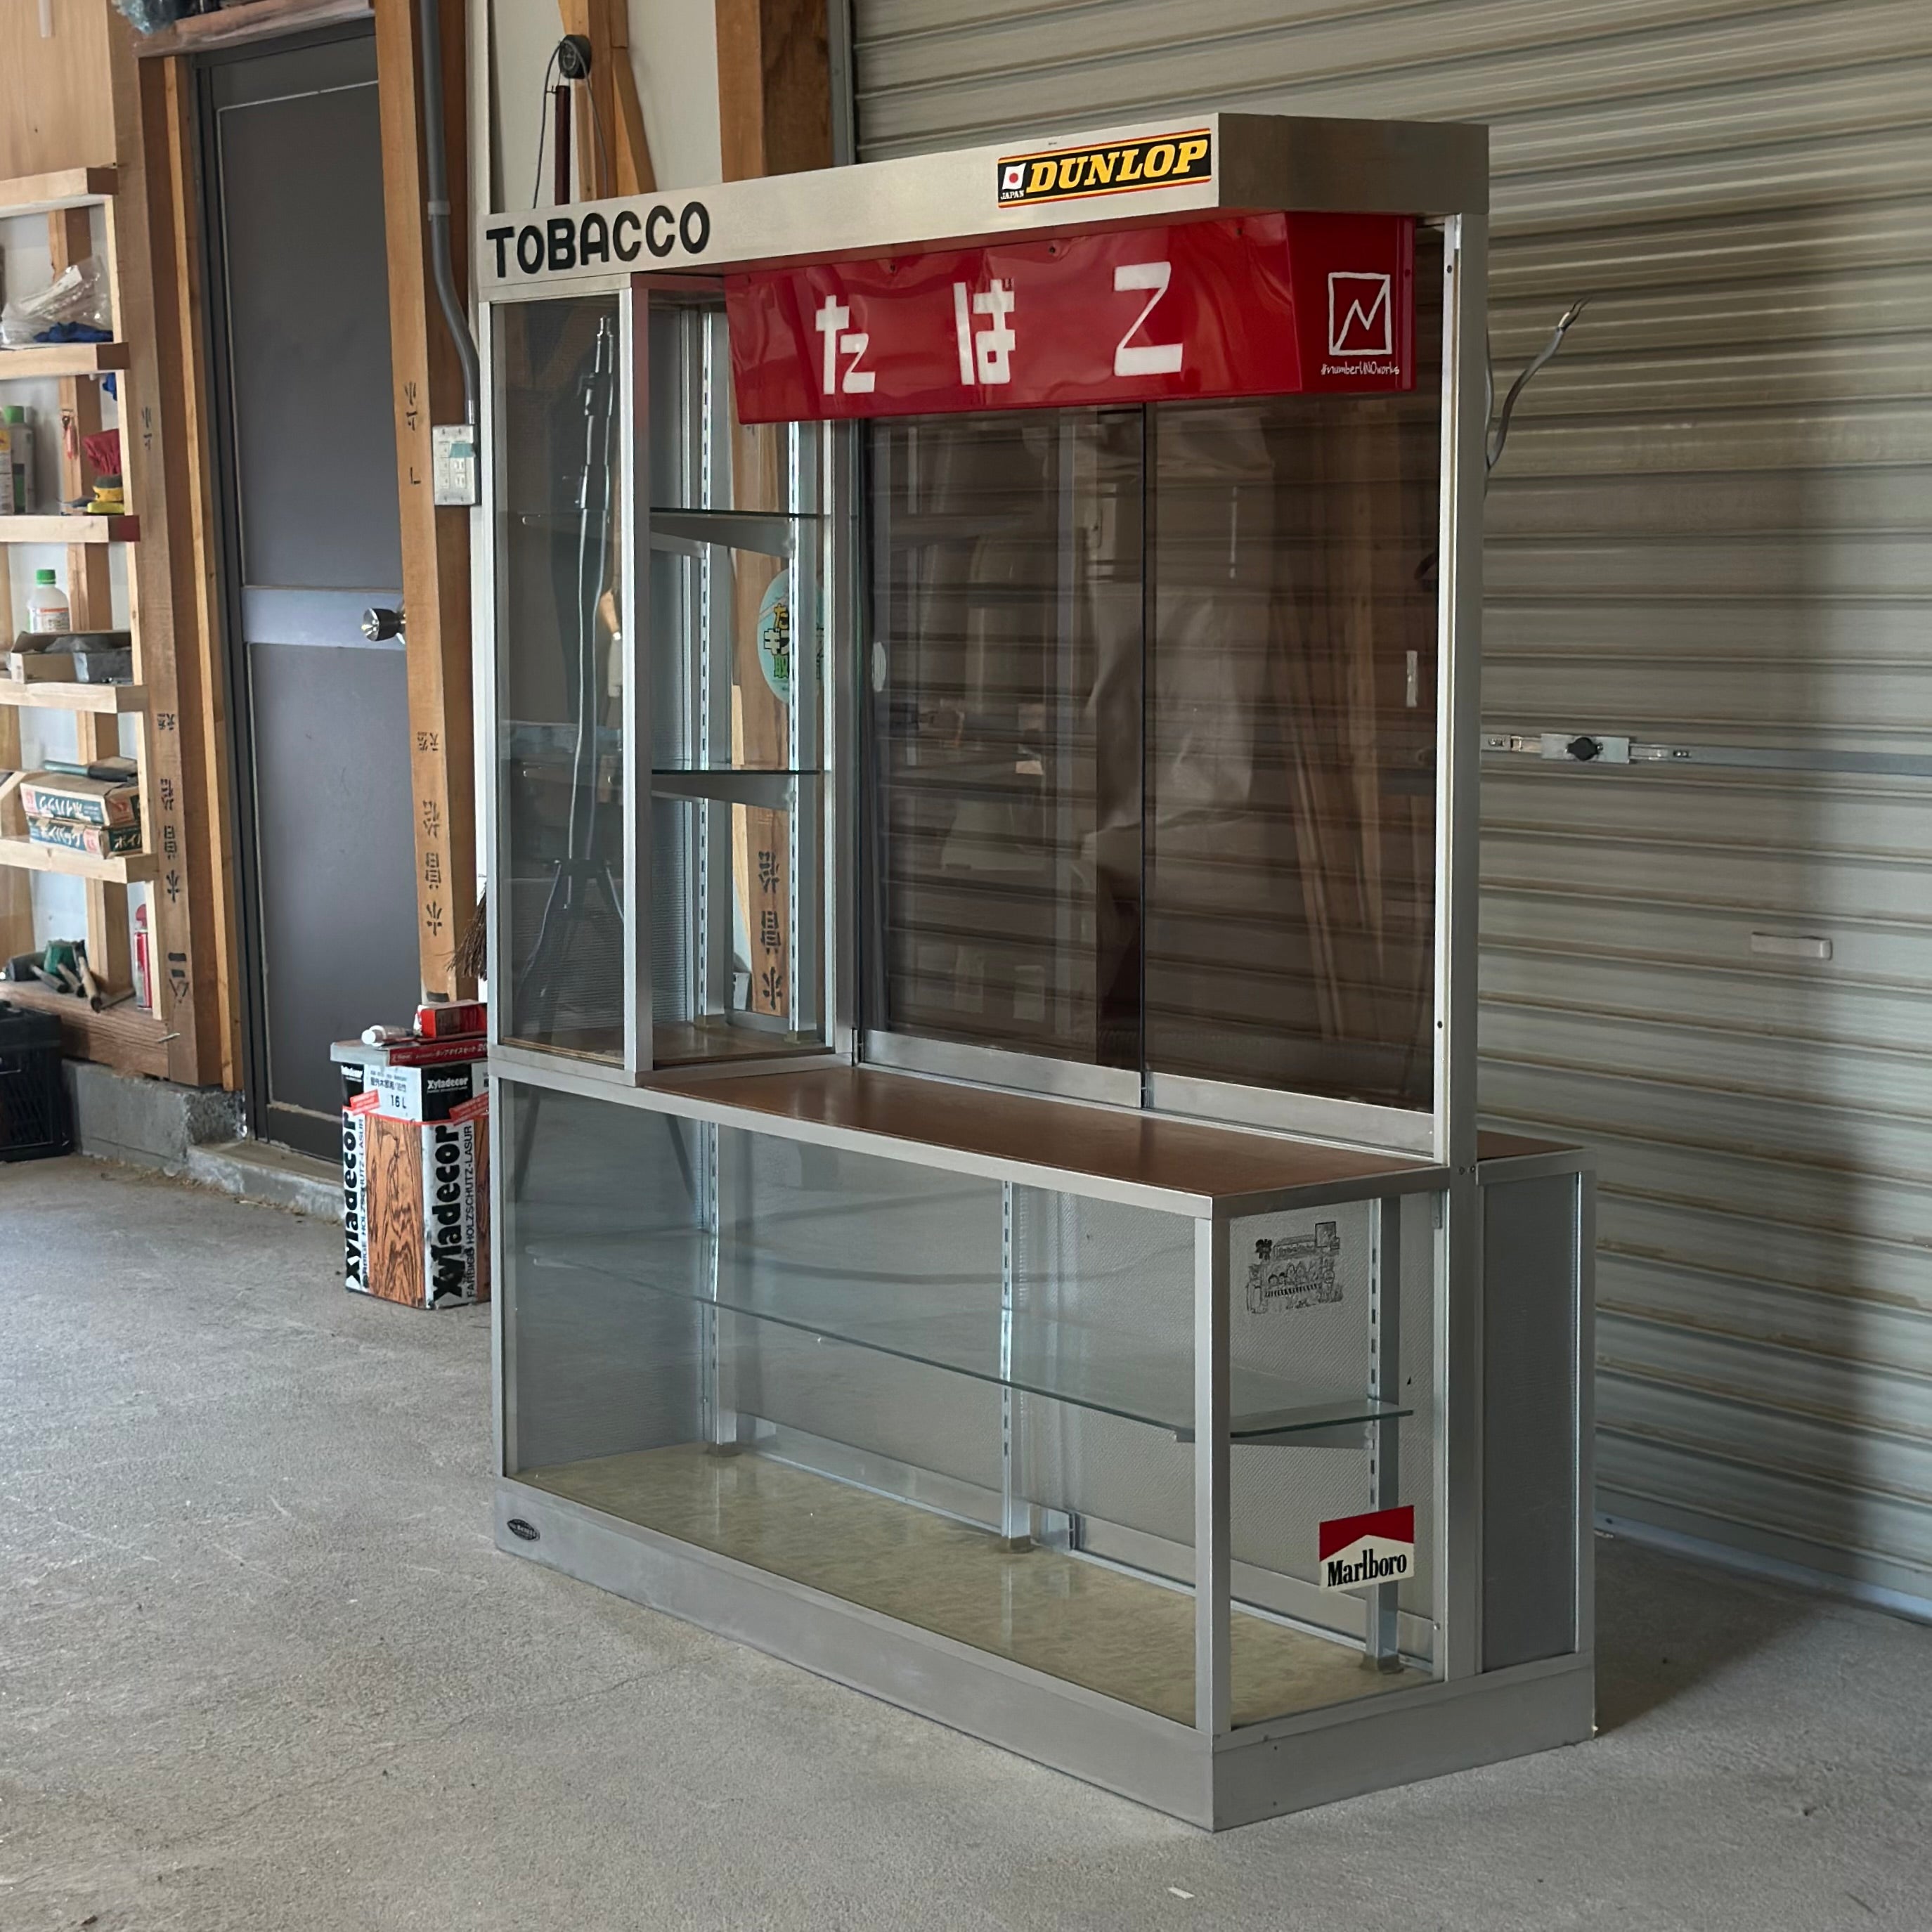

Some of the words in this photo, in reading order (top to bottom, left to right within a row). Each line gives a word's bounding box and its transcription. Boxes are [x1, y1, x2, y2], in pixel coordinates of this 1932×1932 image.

[1000, 189, 1025, 200] JAPAN
[1025, 139, 1209, 193] DUNLOP
[486, 201, 711, 278] TOBACCO
[427, 1077, 468, 1090] Xyladecor
[343, 1112, 361, 1285] Xyladecor
[431, 1124, 465, 1300] Xyladecor
[463, 1125, 475, 1245] HOLZSCHUTZ-LASUR
[1328, 1548, 1407, 1587] Marlboro
